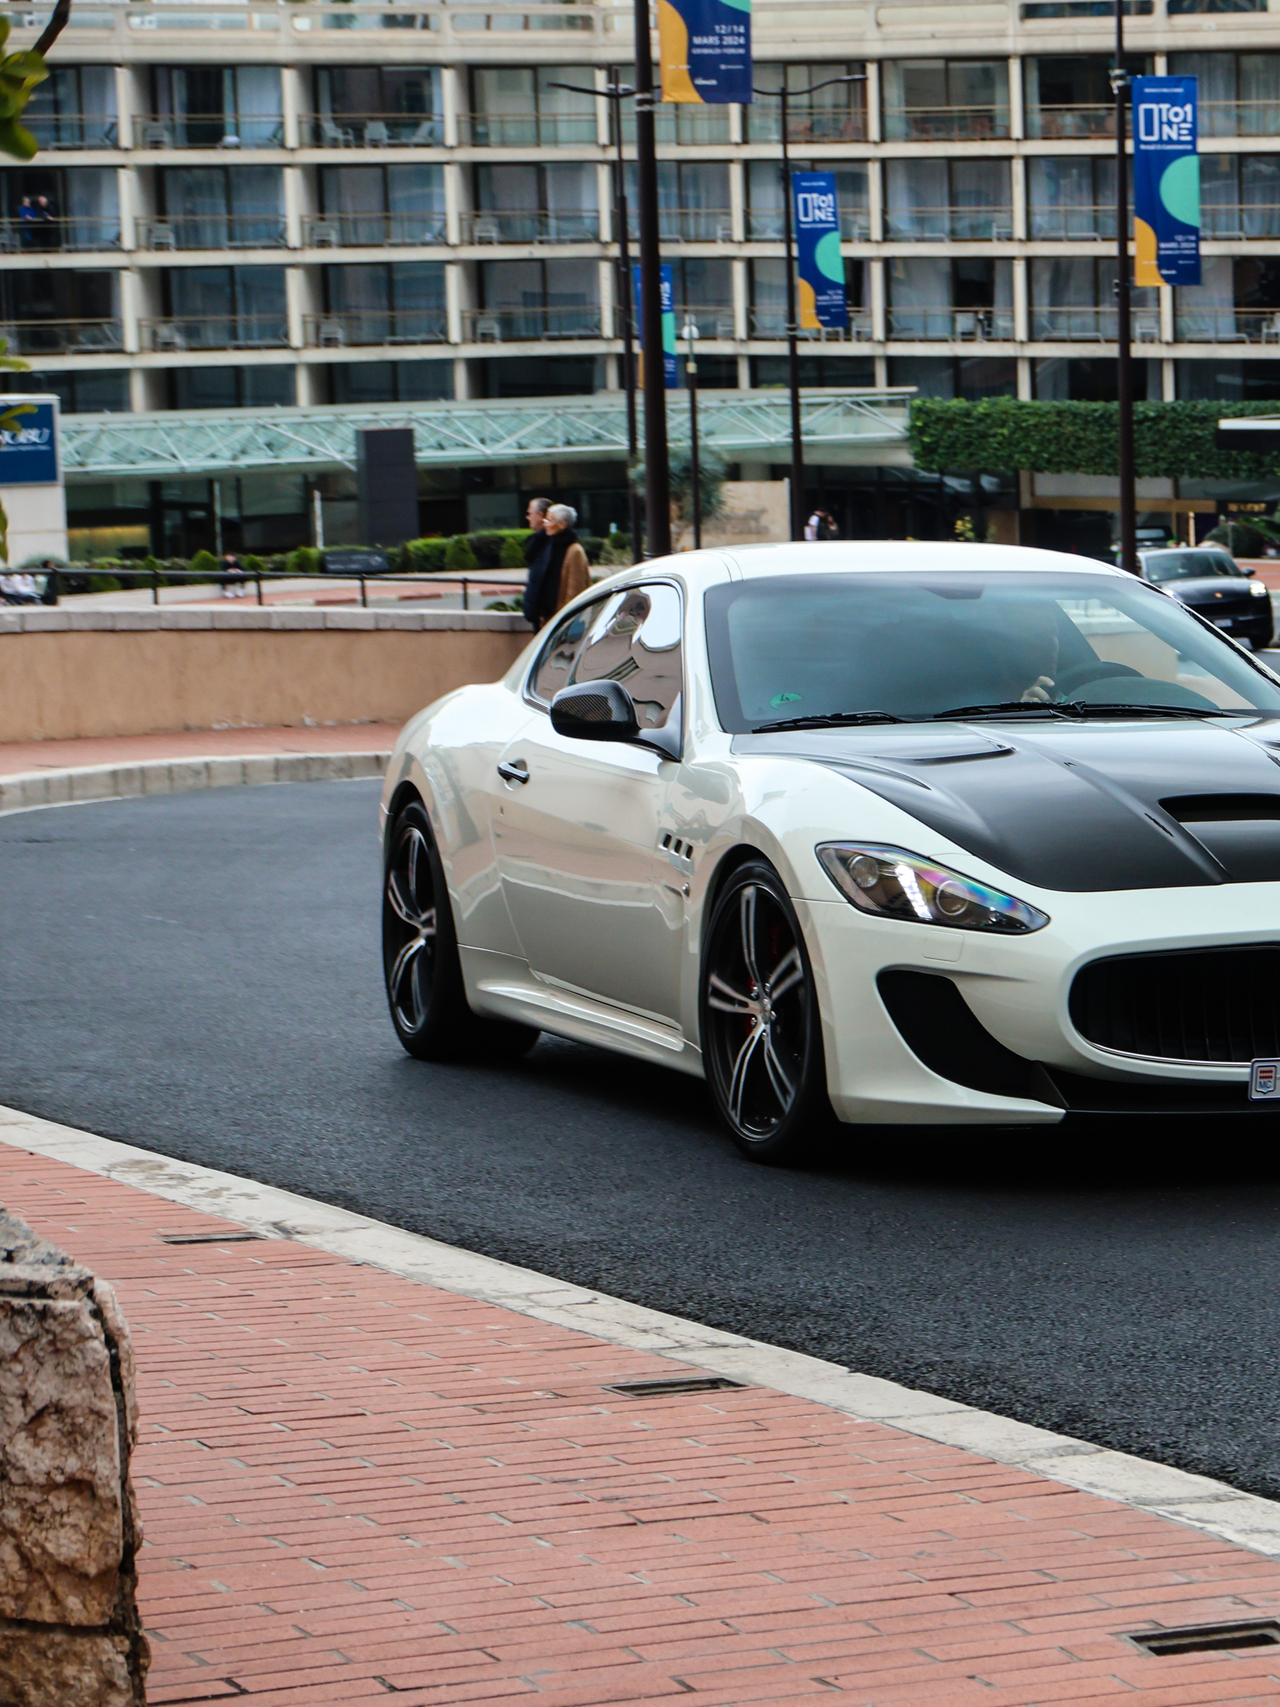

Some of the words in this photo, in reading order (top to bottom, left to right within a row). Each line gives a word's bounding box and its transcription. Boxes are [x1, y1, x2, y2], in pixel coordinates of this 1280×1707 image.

[714, 24, 745, 34] 12/14
[692, 36, 720, 45] MARS
[721, 36, 746, 45] 2024
[1258, 1080, 1273, 1090] MC
